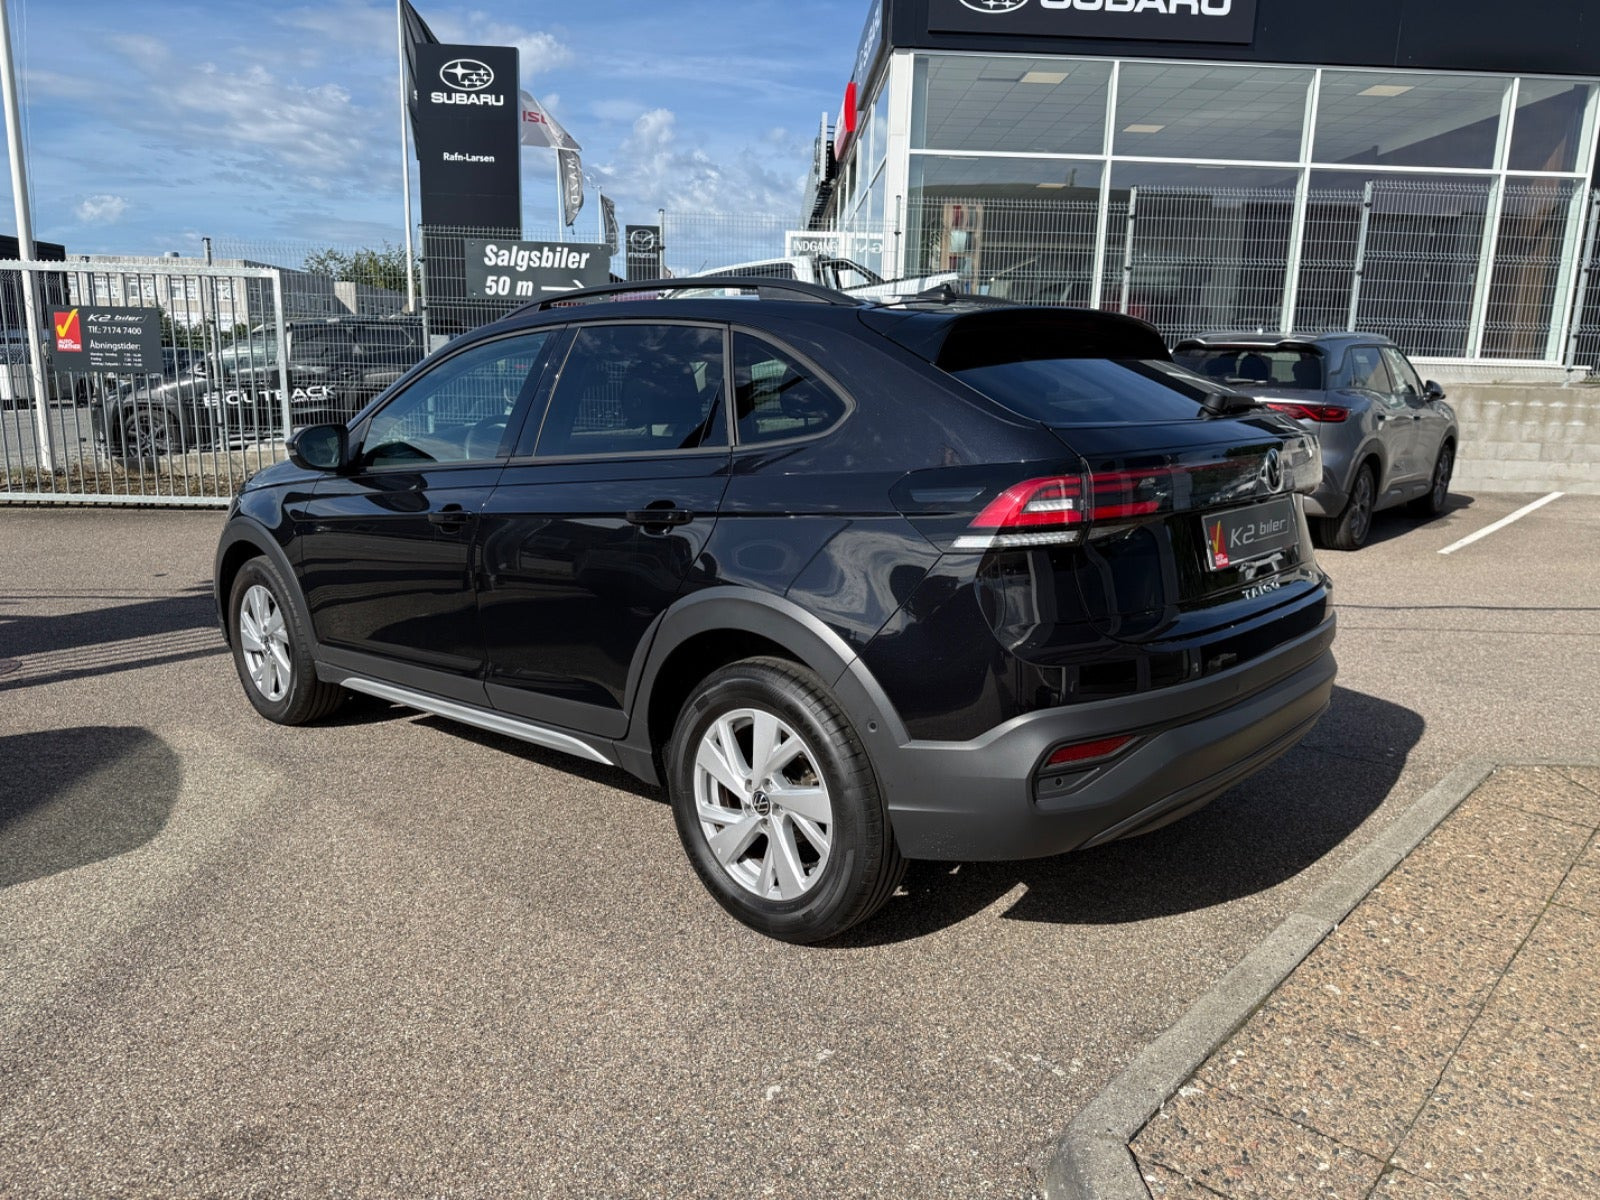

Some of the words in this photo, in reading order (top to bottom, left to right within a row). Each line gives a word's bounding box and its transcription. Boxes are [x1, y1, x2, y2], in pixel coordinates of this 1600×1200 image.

[430, 91, 505, 106] SUBARU
[443, 152, 495, 163] Rafn-Larsen
[483, 244, 590, 272] Salgsbiler
[484, 275, 511, 297] 50
[515, 281, 534, 297] m
[87, 314, 112, 322] K2
[114, 314, 142, 322] biler
[102, 326, 122, 334] 7174
[123, 327, 142, 335] 7400
[90, 340, 141, 351] Åbningstider:
[1230, 524, 1255, 548] K2
[1260, 519, 1286, 535] biler
